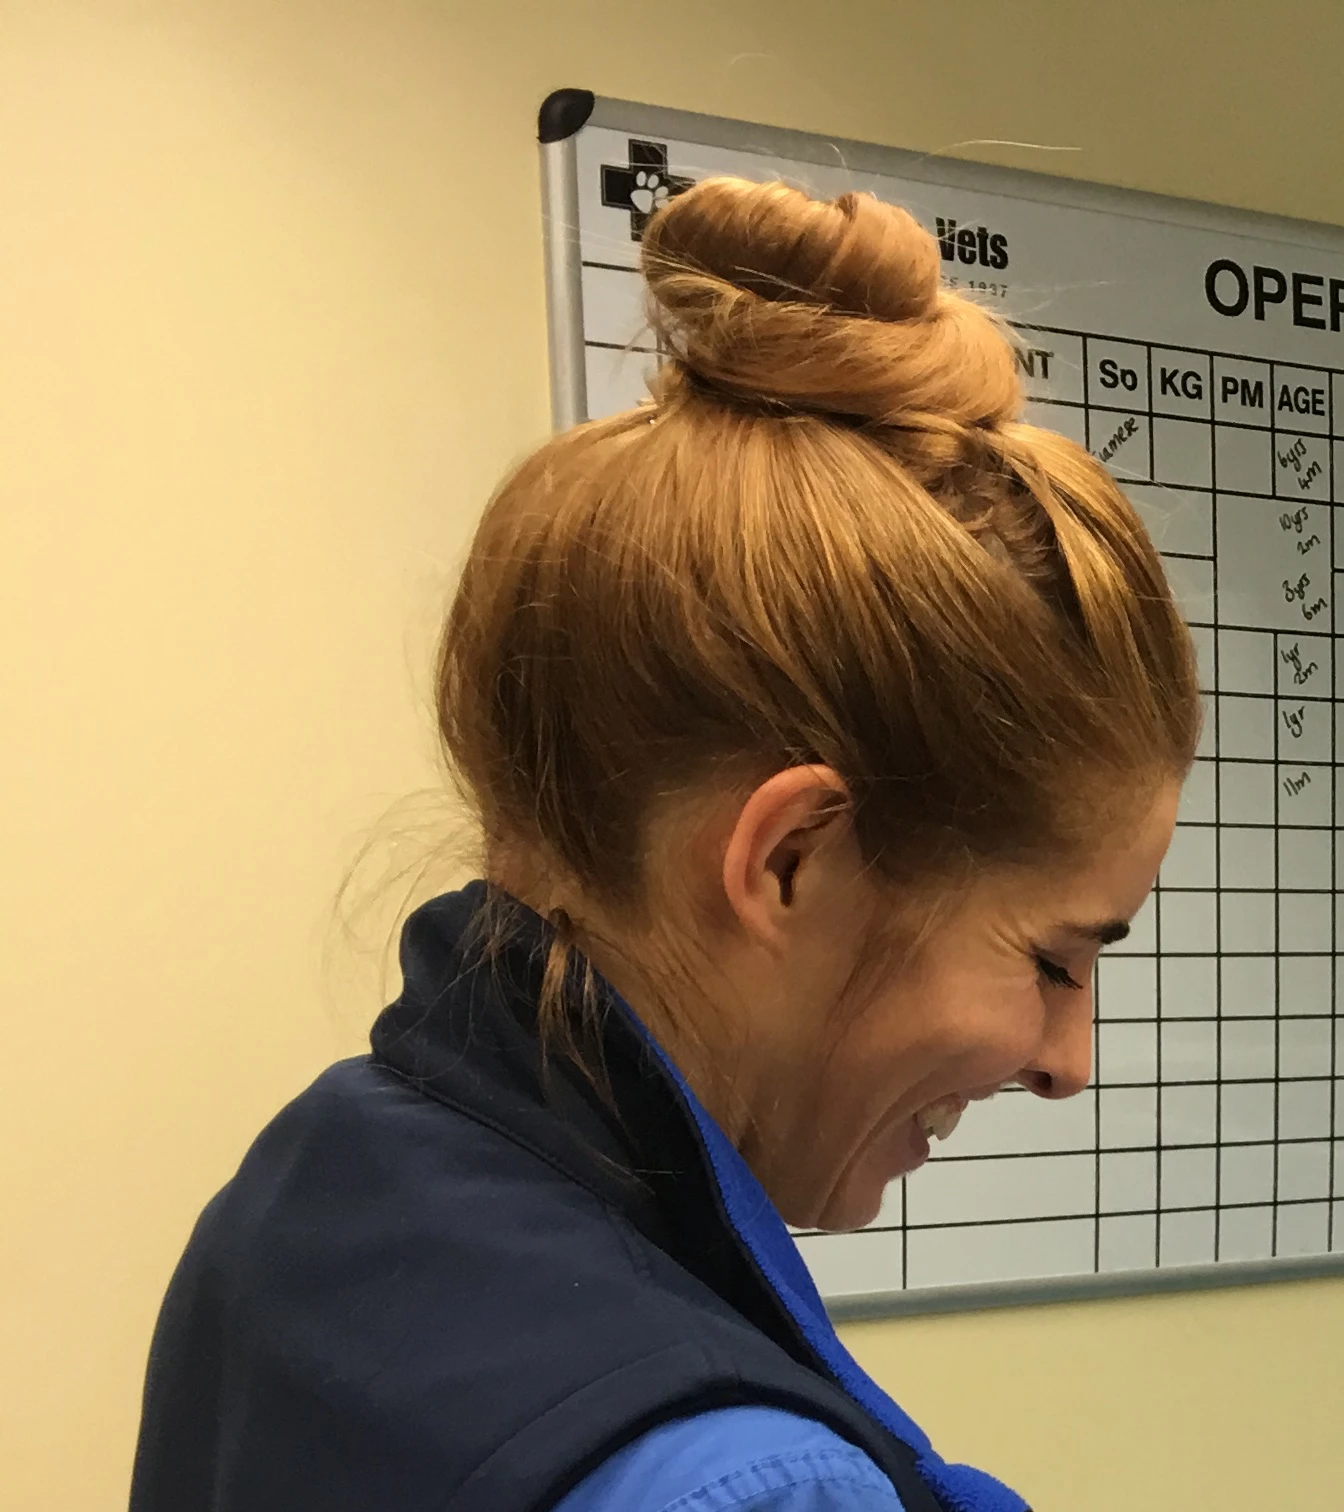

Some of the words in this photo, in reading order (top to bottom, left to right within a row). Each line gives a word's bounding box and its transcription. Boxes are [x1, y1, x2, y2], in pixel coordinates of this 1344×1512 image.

[936, 217, 1009, 270] Vets
[1015, 347, 1055, 379] NT
[1160, 367, 1203, 400] KG
[1221, 376, 1264, 408] PM
[1277, 385, 1325, 416] AGE
